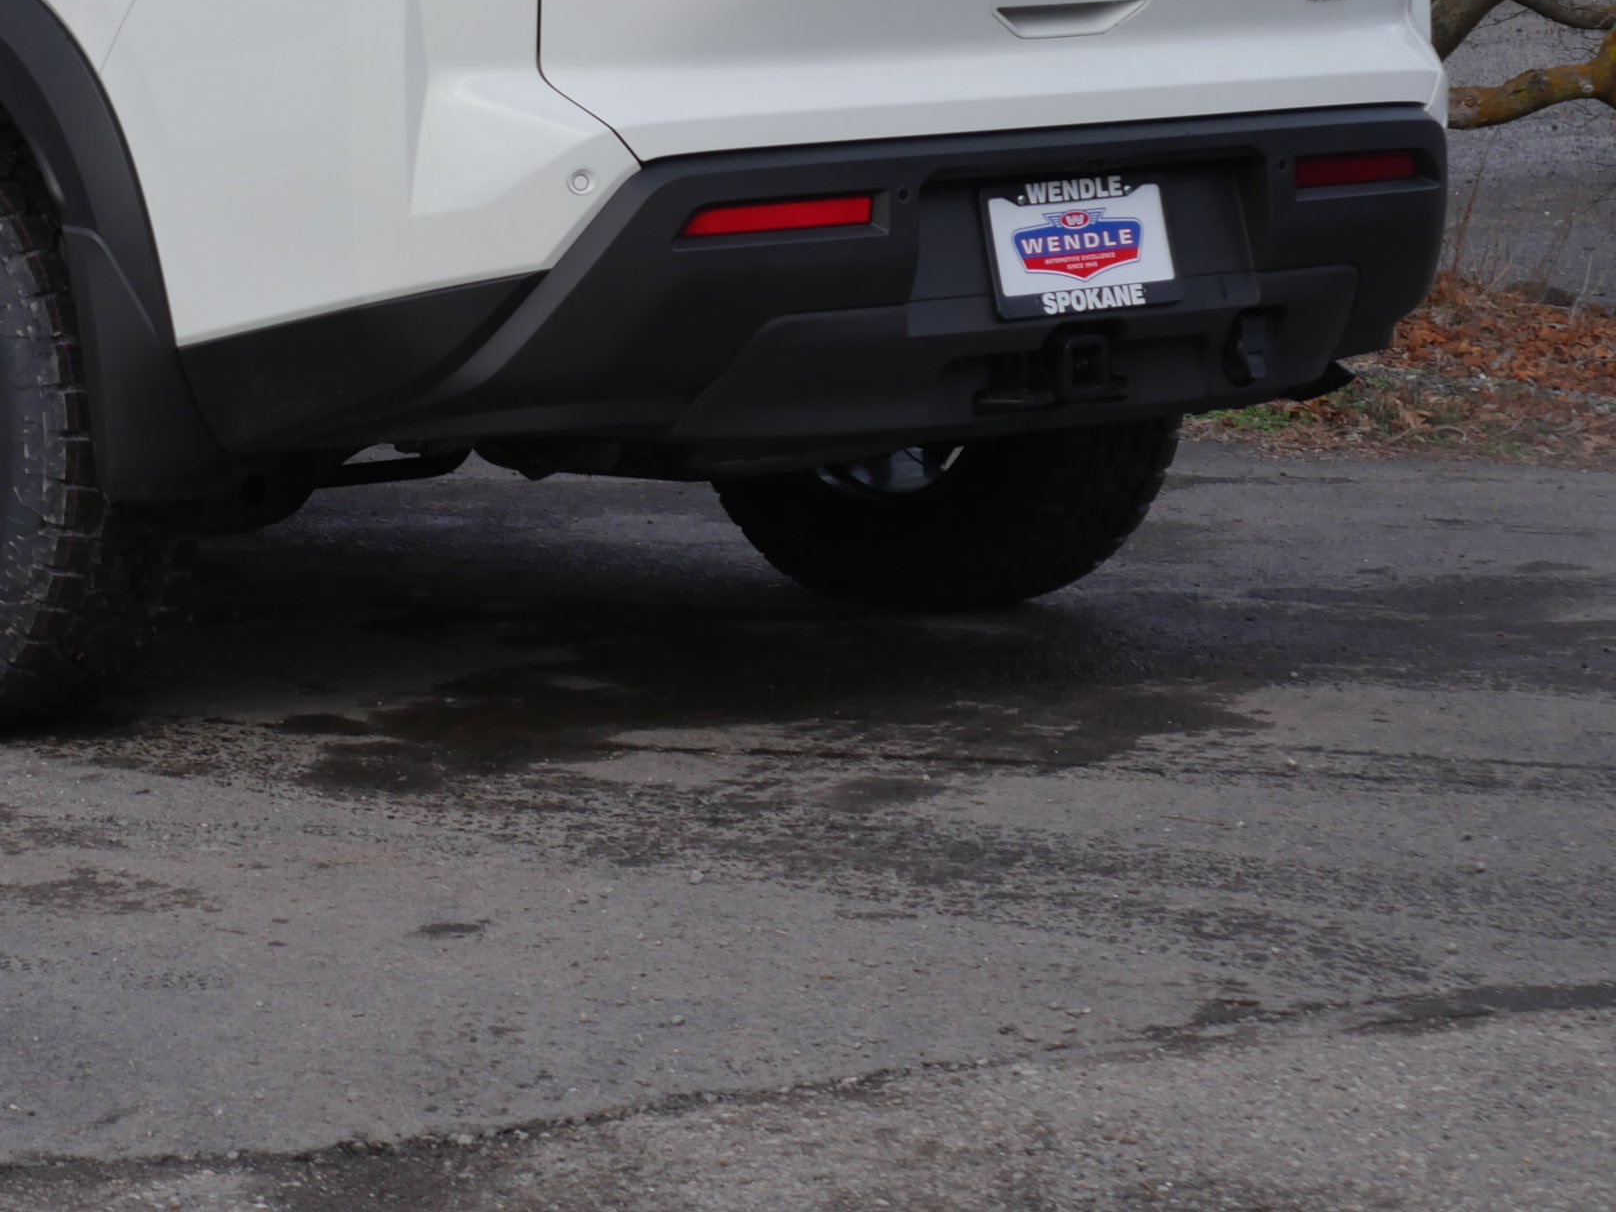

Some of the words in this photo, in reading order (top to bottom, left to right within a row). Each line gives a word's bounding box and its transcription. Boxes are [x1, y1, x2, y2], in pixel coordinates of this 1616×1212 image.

[1025, 175, 1123, 204] WENDLE
[1021, 229, 1133, 254] WENDLE
[1041, 284, 1146, 315] SPOKANE
